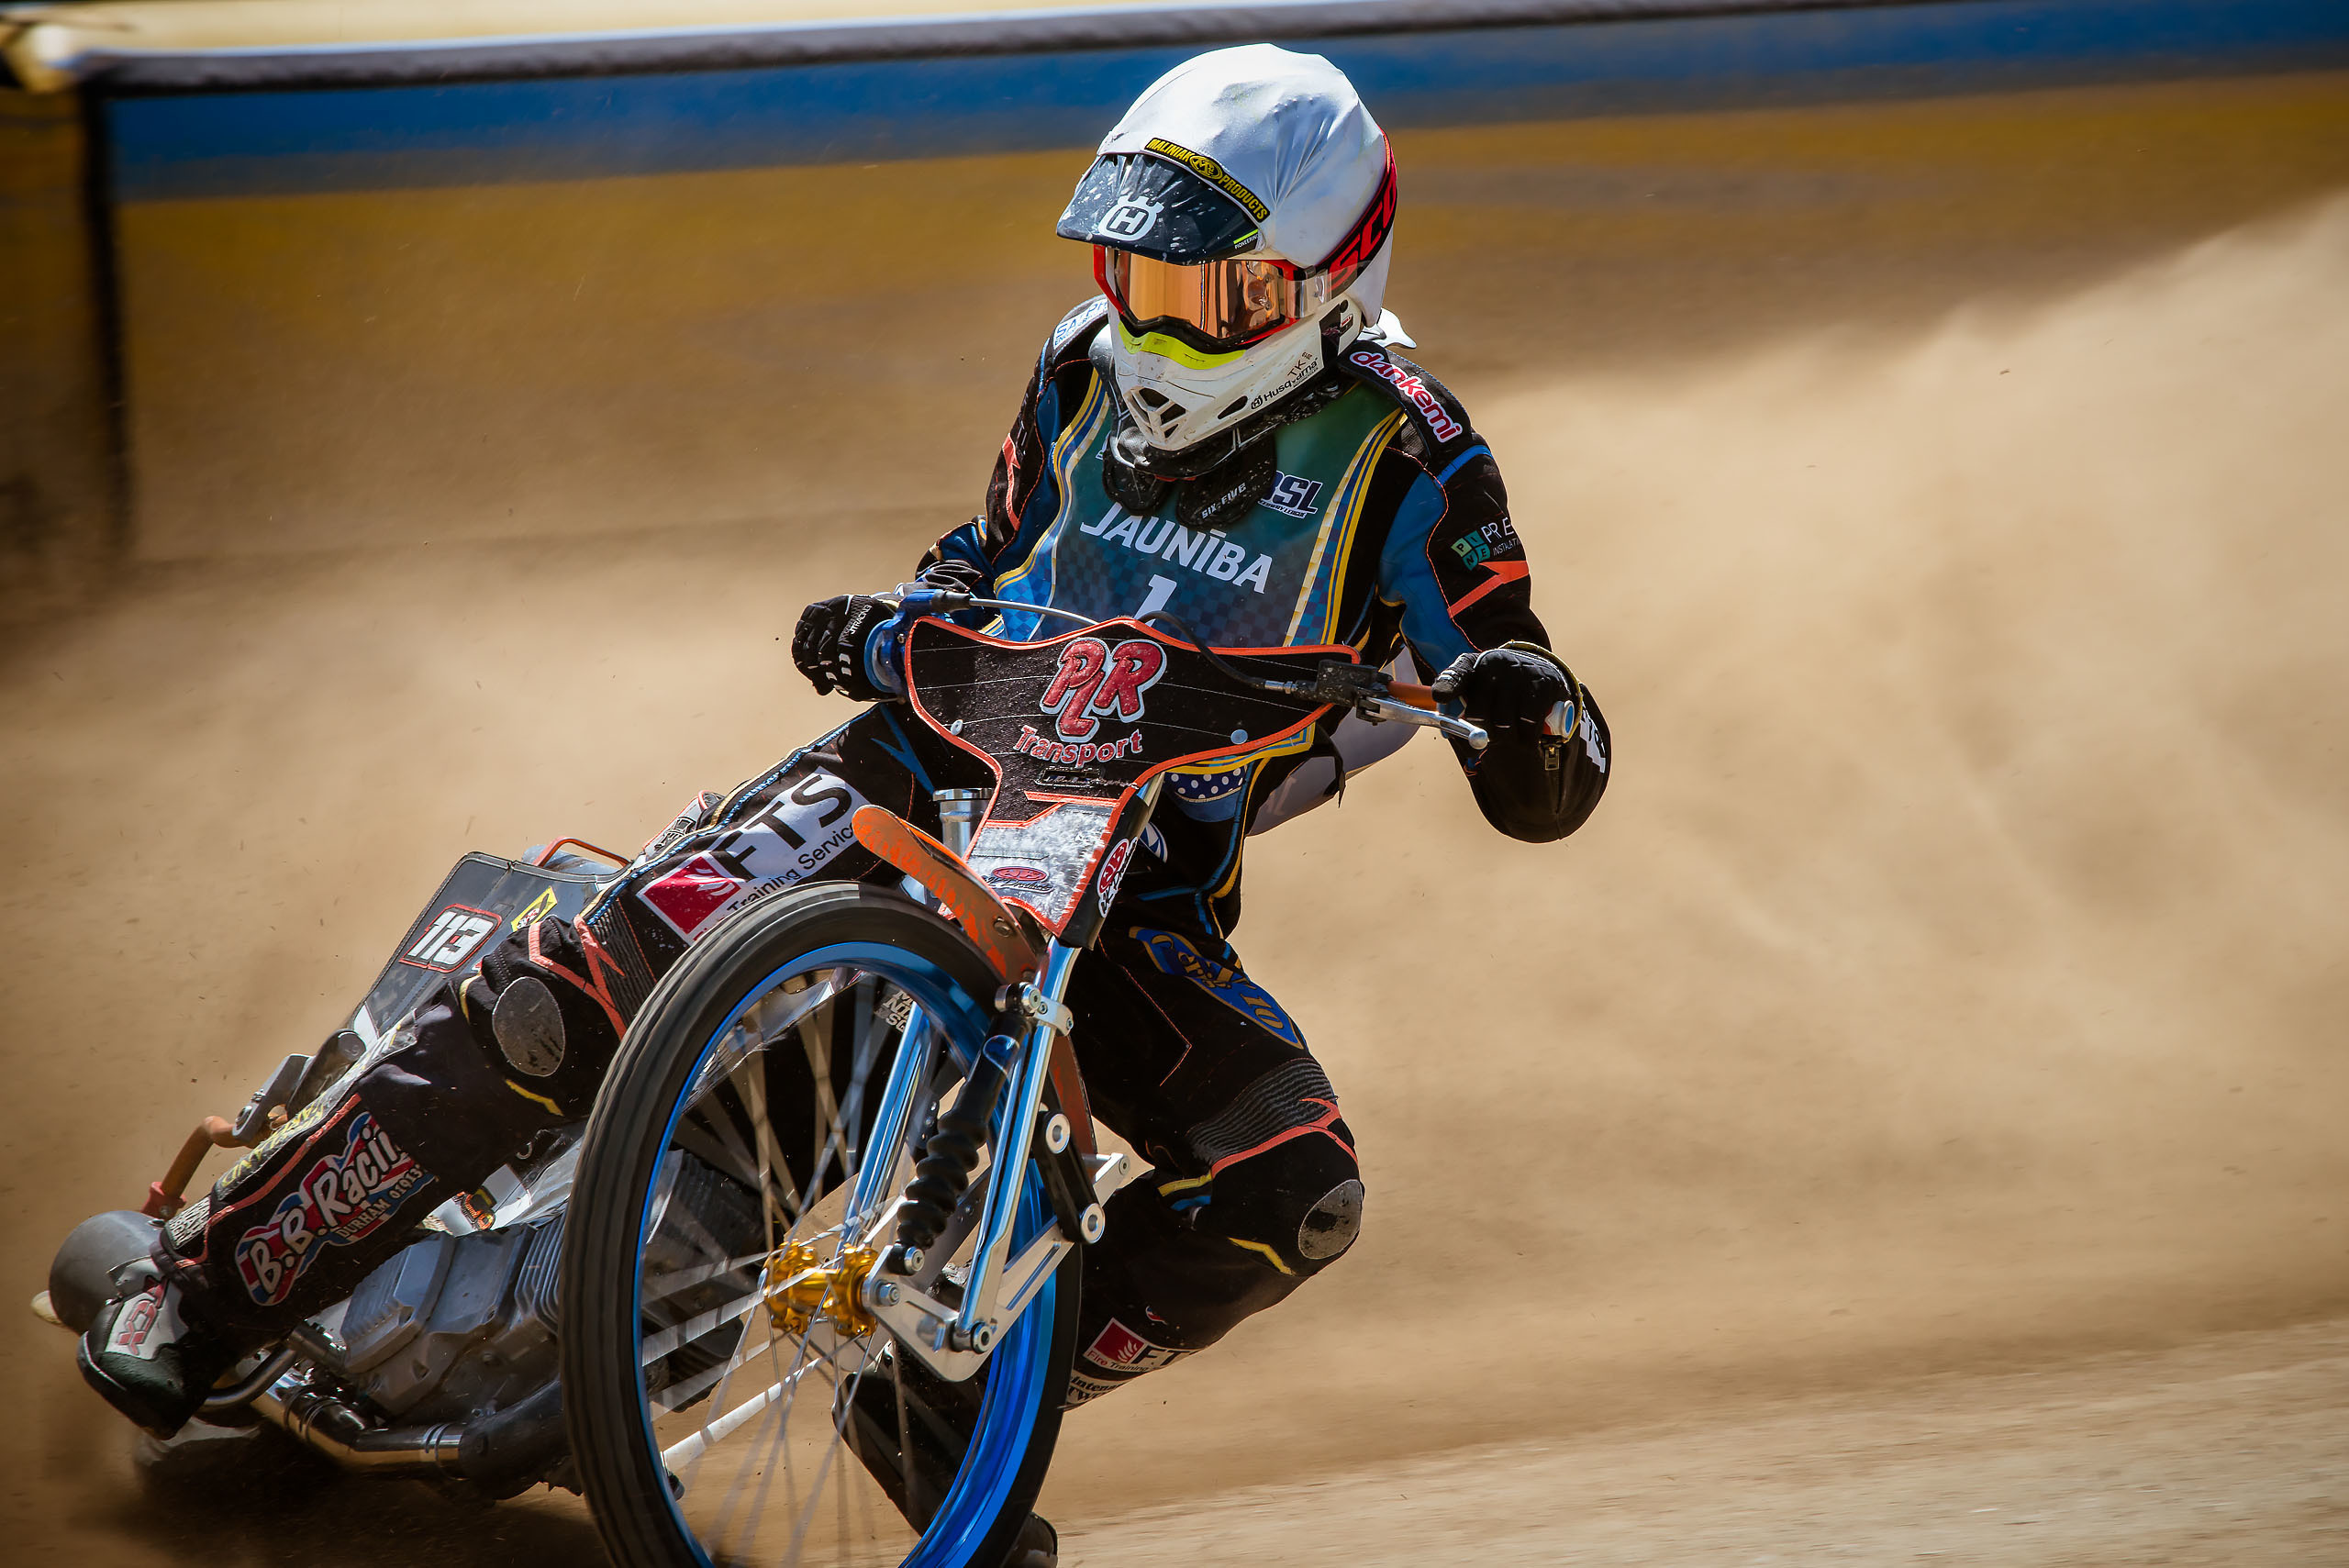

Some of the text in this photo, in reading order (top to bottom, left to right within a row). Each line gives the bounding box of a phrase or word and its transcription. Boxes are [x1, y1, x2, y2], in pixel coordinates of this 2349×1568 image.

[1146, 139, 1268, 220] MALINIAK PRODUCTS
[1349, 350, 1464, 443] dankemi
[1079, 502, 1273, 595] JAUNĪBA
[1013, 724, 1143, 768] Transport
[708, 774, 853, 883] FTS
[727, 825, 857, 911] Training Servic
[406, 910, 495, 966] 113
[336, 1198, 392, 1239] DURHAM
[1085, 1350, 1108, 1366] Fire
